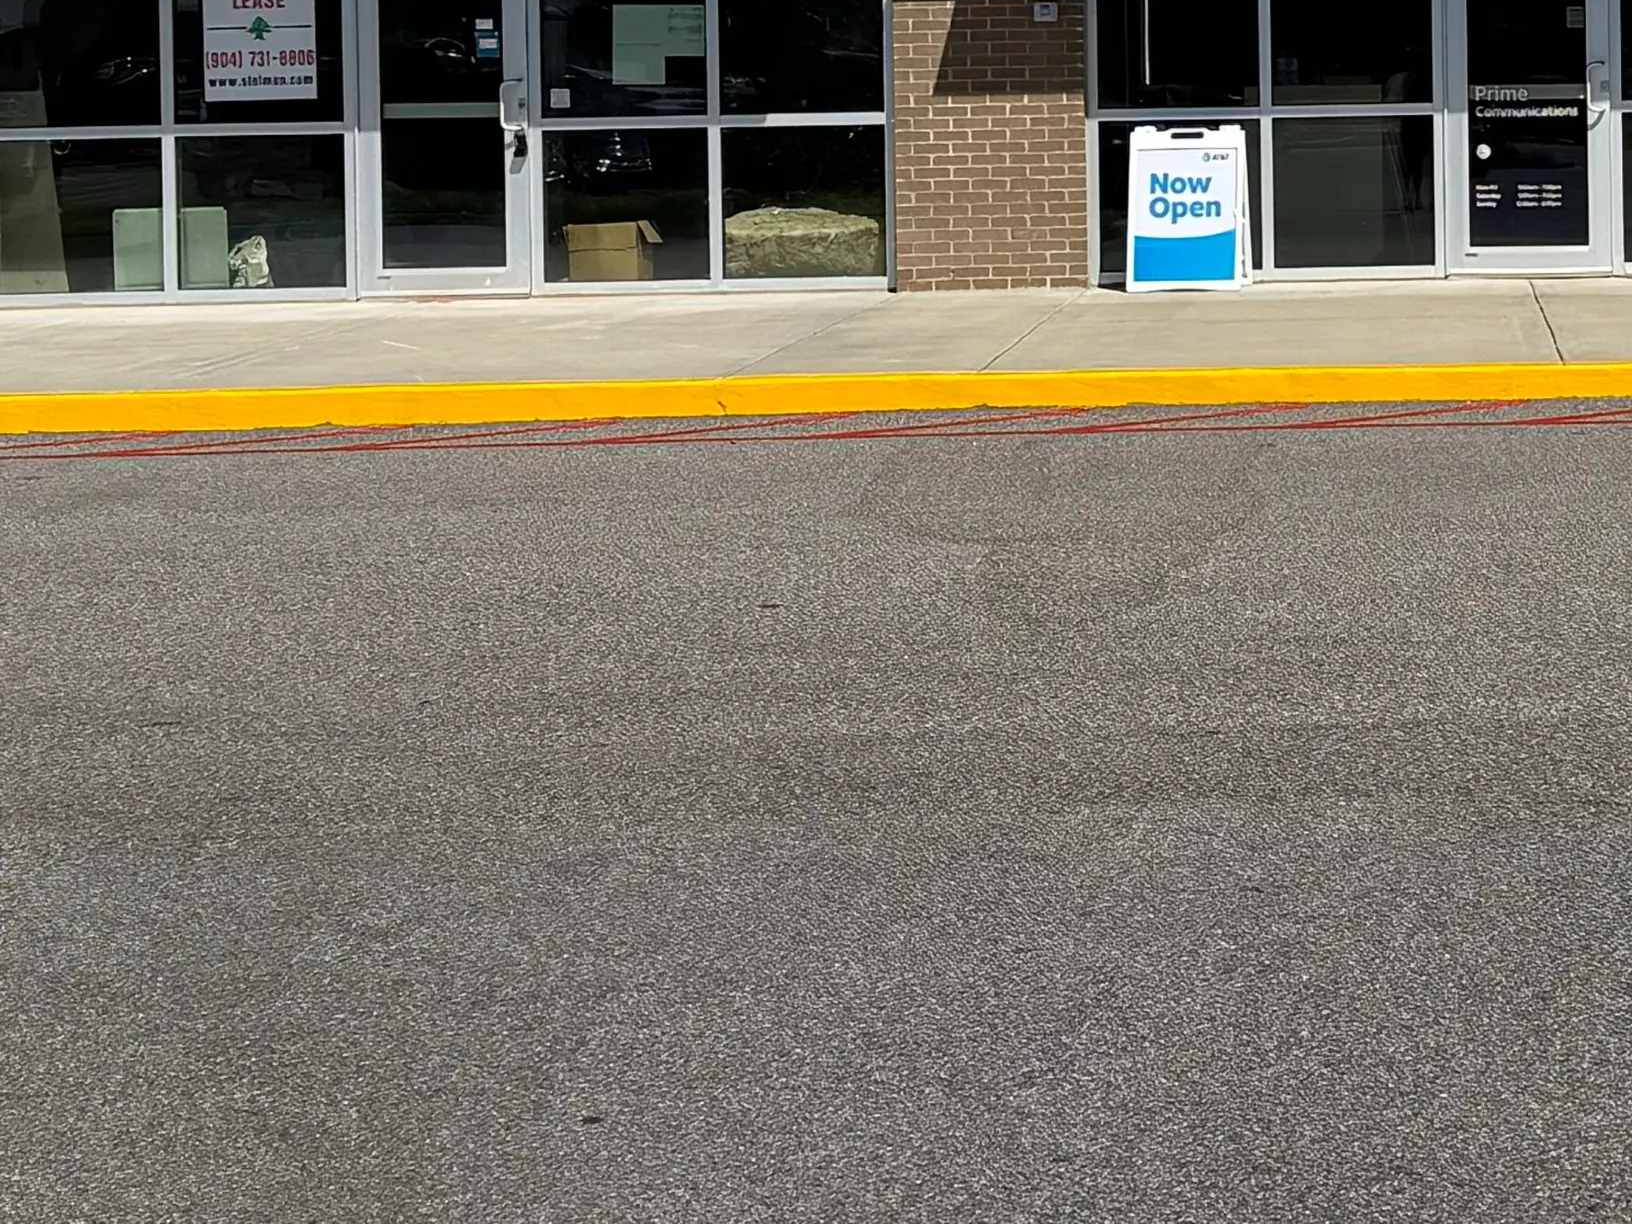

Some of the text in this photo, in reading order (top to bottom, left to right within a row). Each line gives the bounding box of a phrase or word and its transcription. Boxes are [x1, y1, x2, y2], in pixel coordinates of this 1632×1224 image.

[206, 50, 243, 69] (904)
[1475, 85, 1528, 101] Prime
[1475, 105, 1579, 117] Communications
[1150, 172, 1213, 195] Now
[1149, 196, 1222, 225] Open
